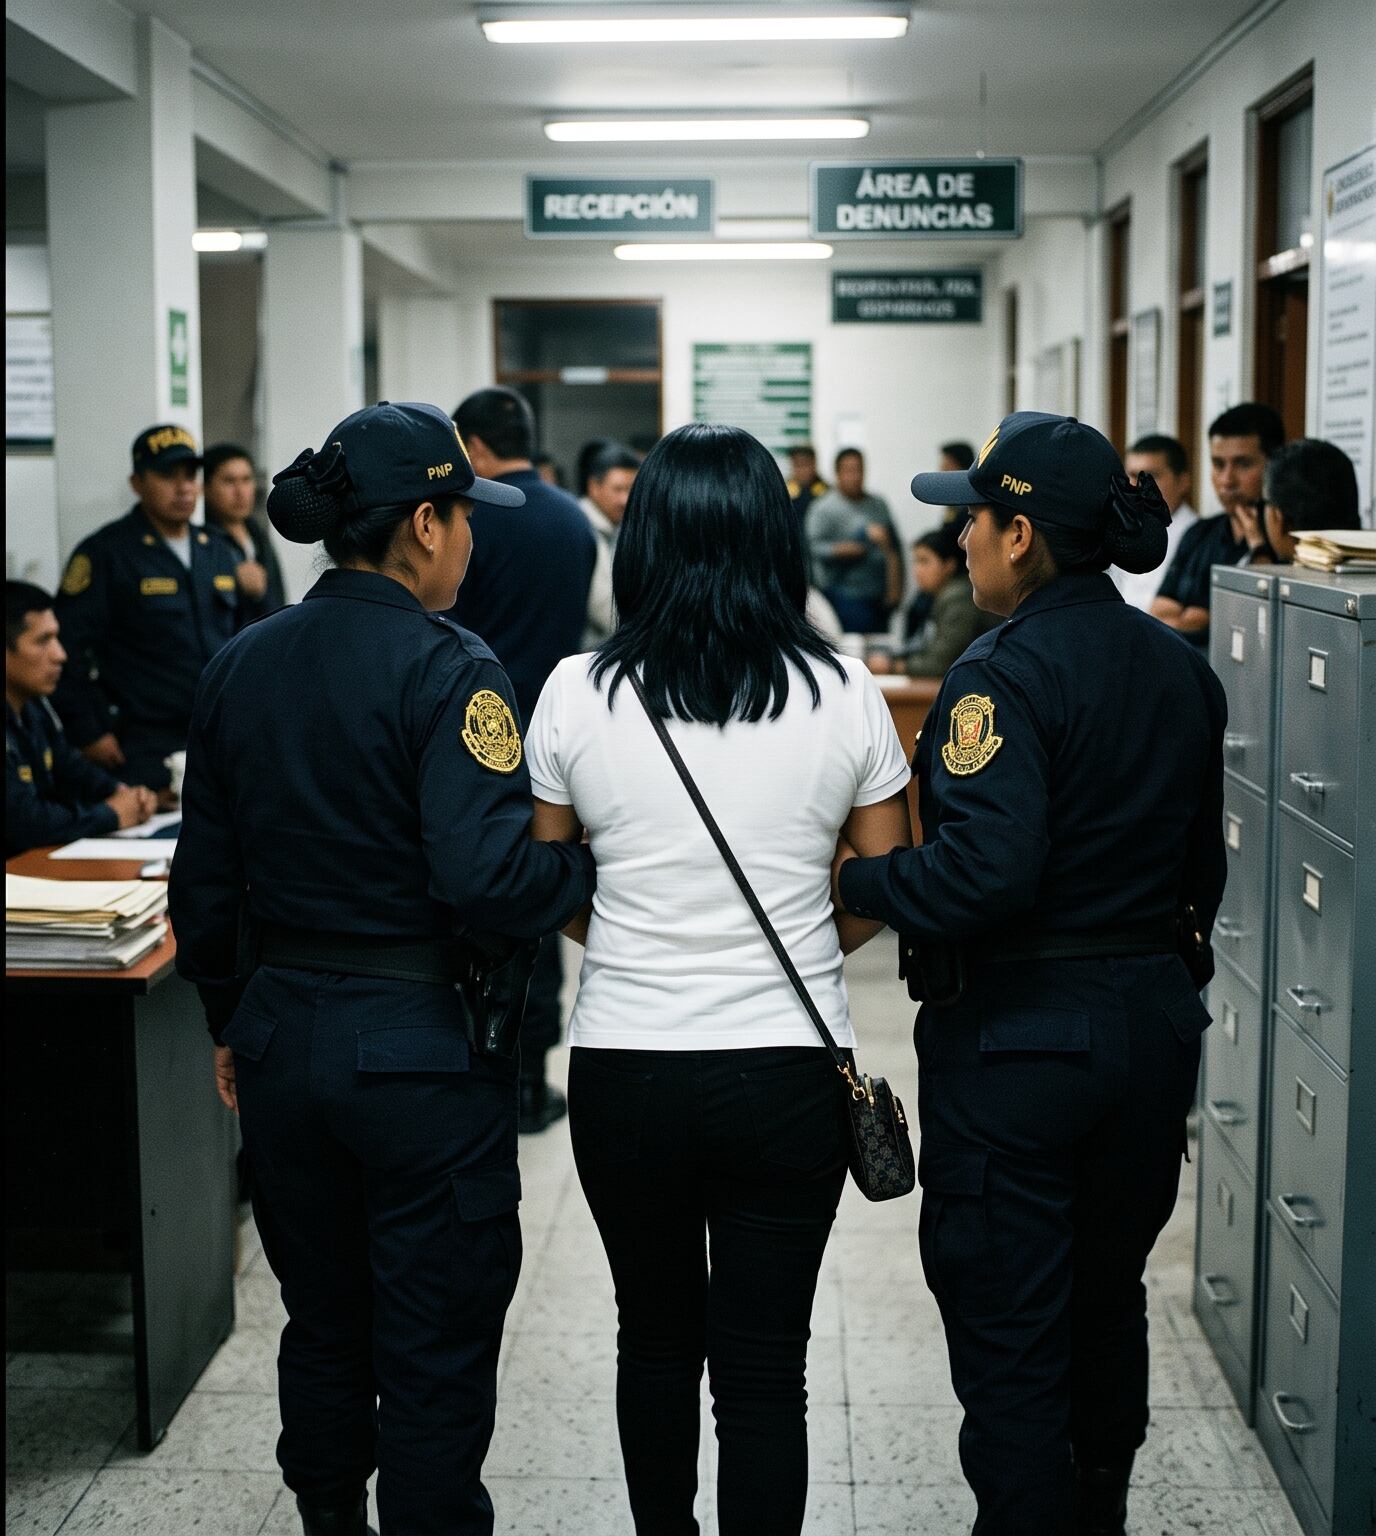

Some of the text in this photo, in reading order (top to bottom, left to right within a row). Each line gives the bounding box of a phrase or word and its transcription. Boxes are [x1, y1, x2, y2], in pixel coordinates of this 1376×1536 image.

[855, 168, 976, 199] ÁREA DE
[543, 187, 700, 220] RECEPCIÓN
[835, 203, 995, 231] DENUNCIAS
[427, 462, 453, 480] PNP
[1000, 474, 1033, 496] PNP
